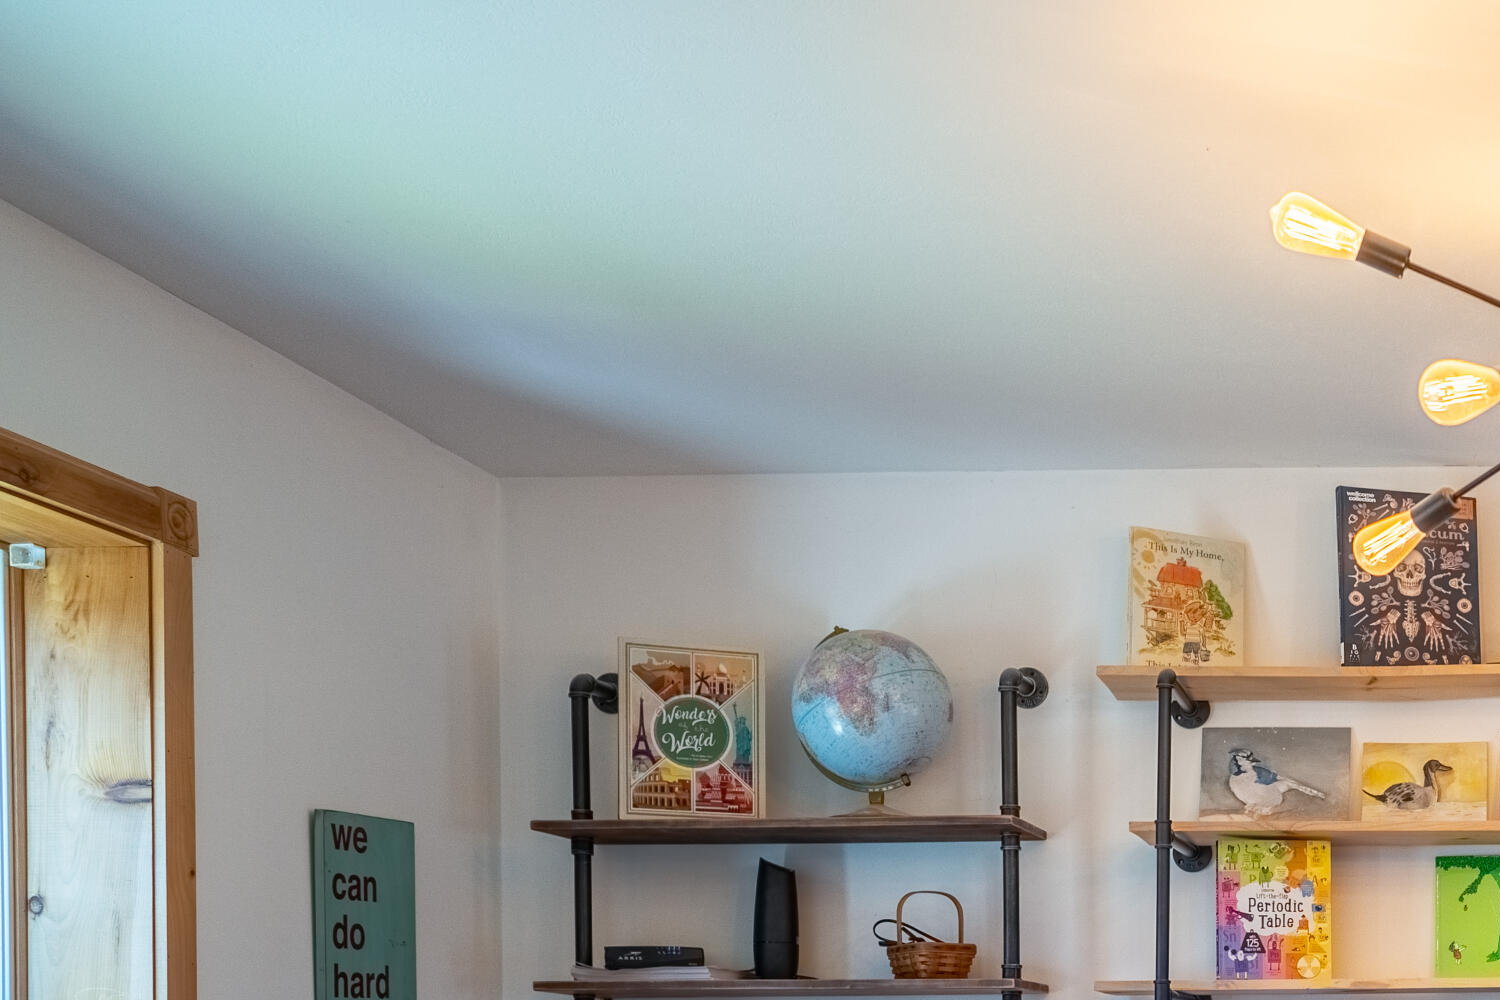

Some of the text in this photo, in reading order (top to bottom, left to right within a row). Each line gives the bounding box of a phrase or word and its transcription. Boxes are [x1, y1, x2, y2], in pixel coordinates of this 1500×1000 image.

[1148, 541, 1168, 553] This
[1170, 544, 1178, 554] Is
[1180, 546, 1193, 559] My
[1196, 549, 1225, 562] Home,
[656, 705, 717, 726] Wonders
[661, 731, 716, 754] World
[331, 822, 368, 854] we
[332, 872, 378, 903] can
[1248, 897, 1304, 913] Periodic
[332, 914, 365, 950] do
[1258, 914, 1294, 929] Table
[1245, 938, 1260, 948] 125
[333, 963, 390, 999] hard
